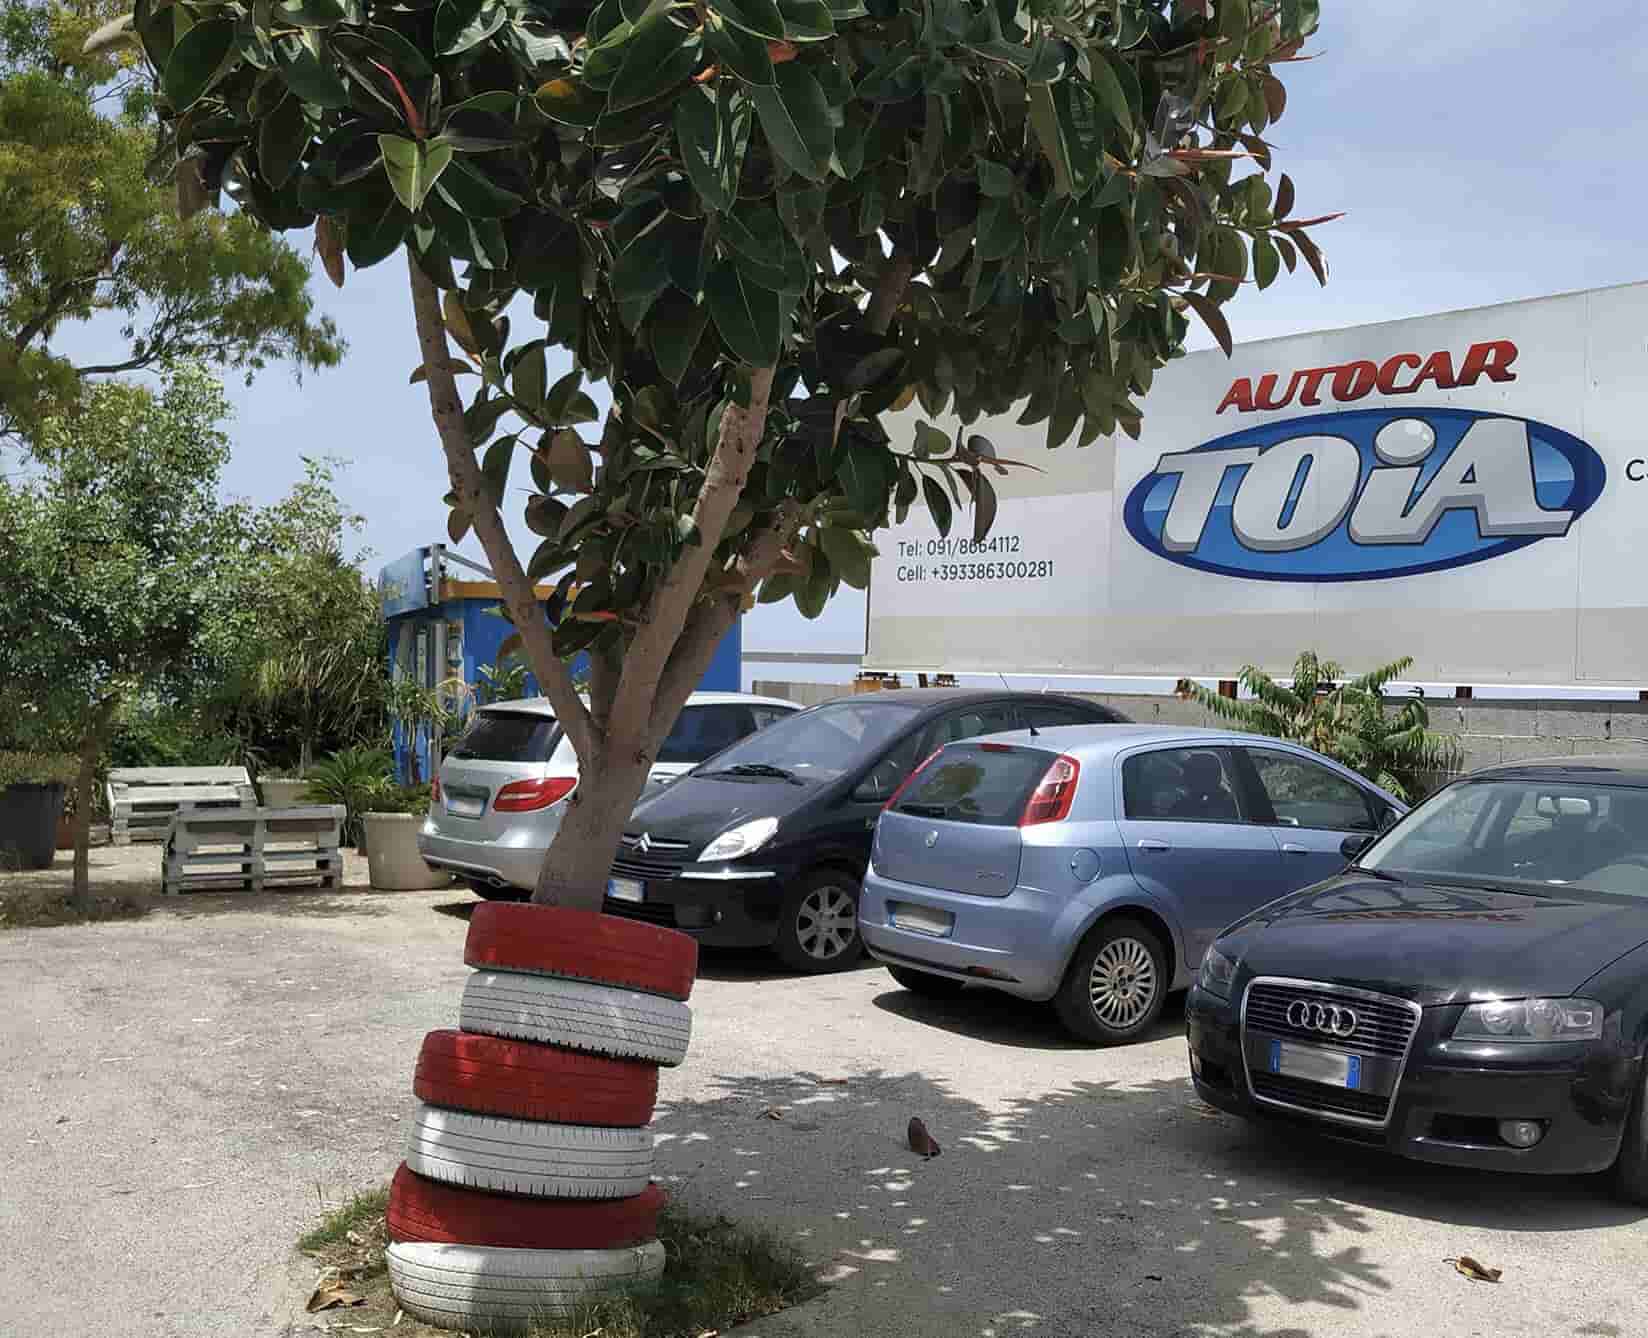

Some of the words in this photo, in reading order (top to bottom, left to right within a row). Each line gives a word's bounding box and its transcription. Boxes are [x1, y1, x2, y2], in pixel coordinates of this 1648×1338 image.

[1216, 339, 1519, 414] AUTOCAR
[1625, 458, 1648, 482] C
[897, 540, 923, 557] Tel:
[897, 565, 927, 582] Cell:
[931, 560, 1054, 581] +393386300281
